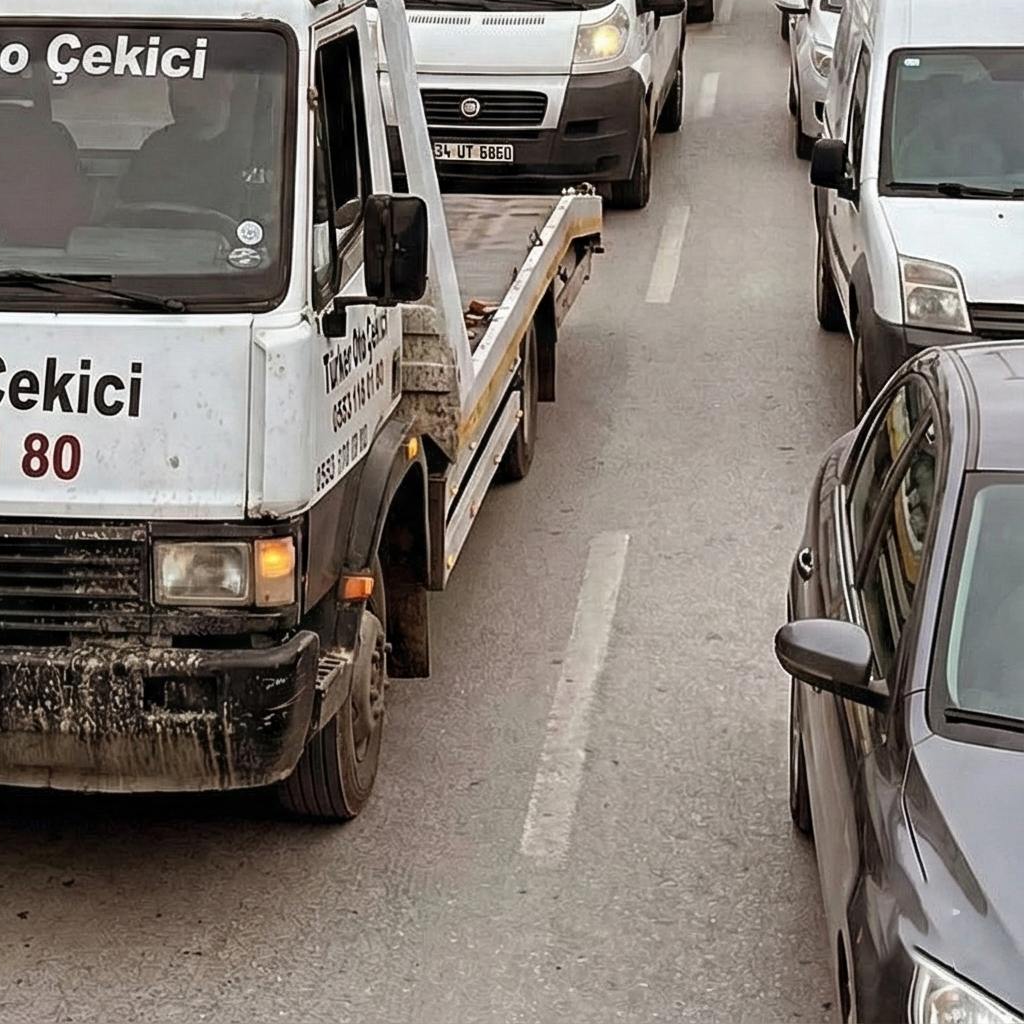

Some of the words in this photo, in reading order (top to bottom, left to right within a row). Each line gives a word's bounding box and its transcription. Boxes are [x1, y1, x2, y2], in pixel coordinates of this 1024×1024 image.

[46, 33, 209, 84] Çekici
[457, 144, 473, 159] UT
[21, 432, 81, 480] 80
